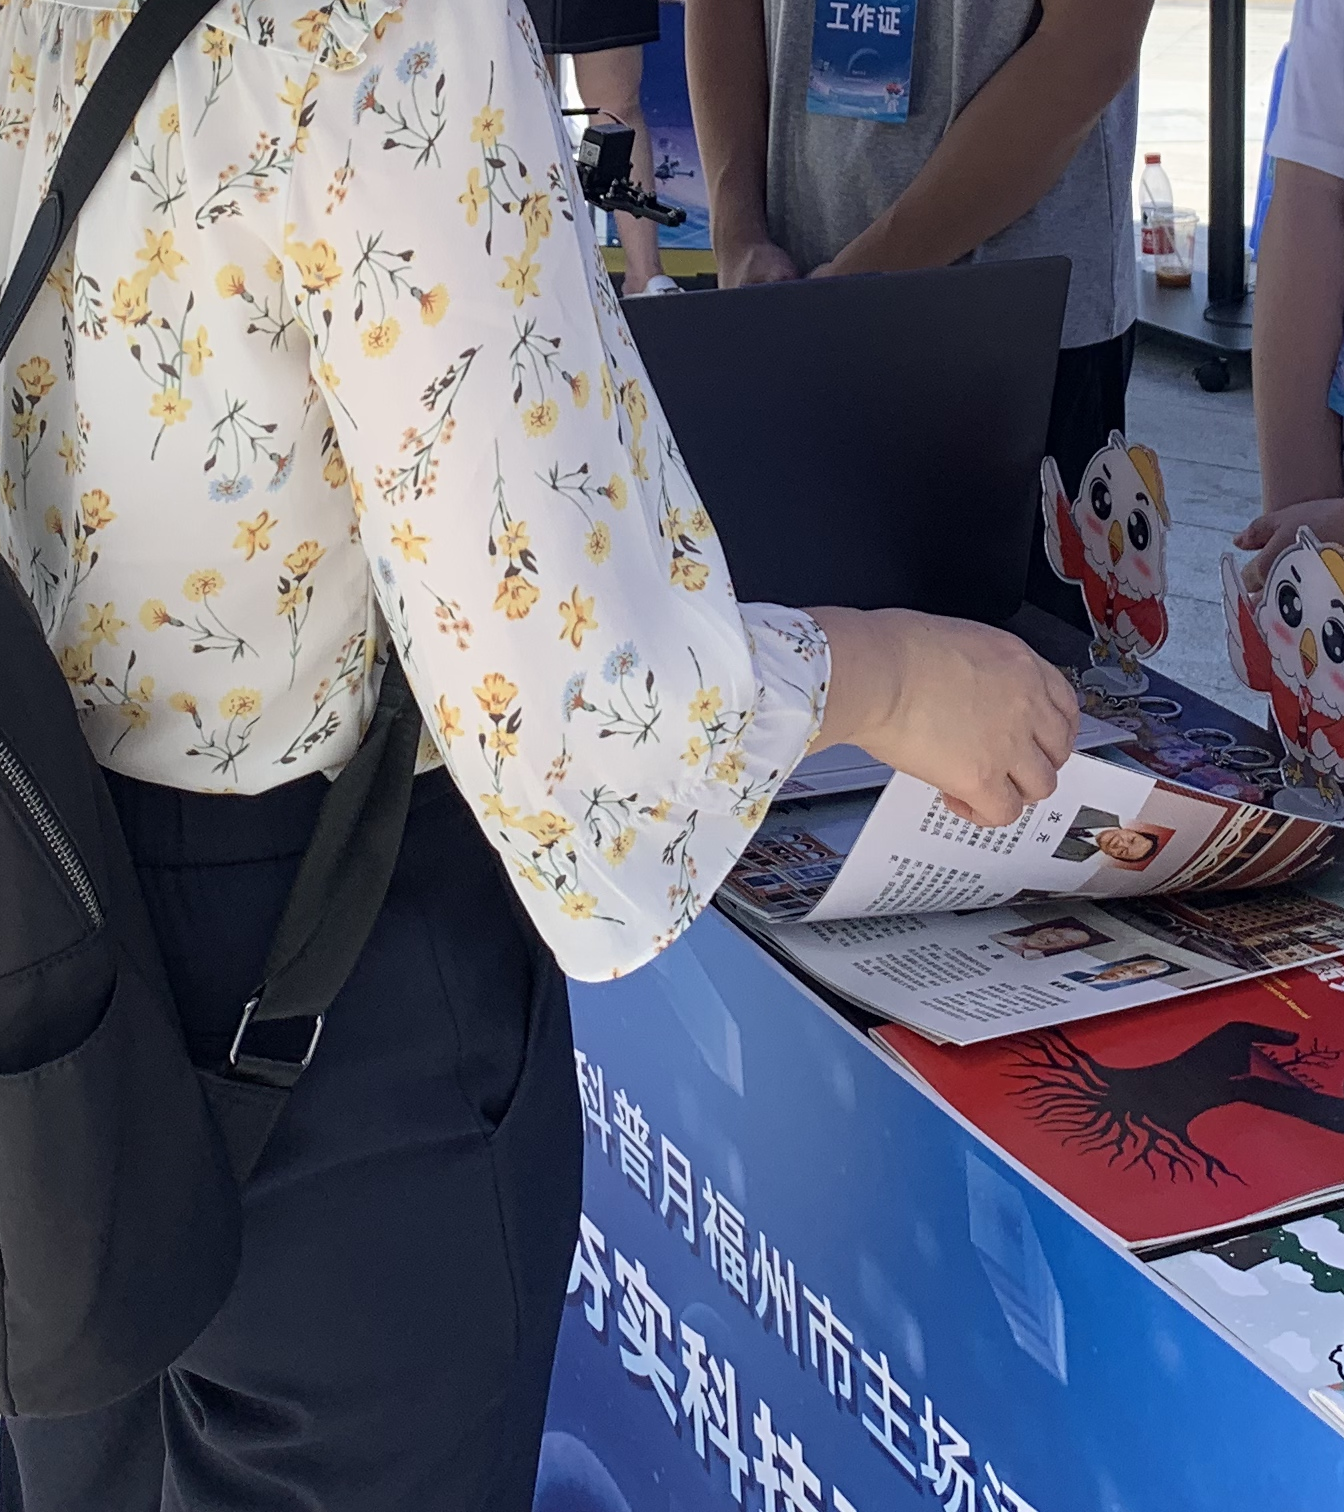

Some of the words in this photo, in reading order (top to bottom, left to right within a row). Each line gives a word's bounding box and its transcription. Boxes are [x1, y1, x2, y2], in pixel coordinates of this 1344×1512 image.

[826, 1, 901, 35] 工作证
[567, 1212, 856, 1512] 实科技
